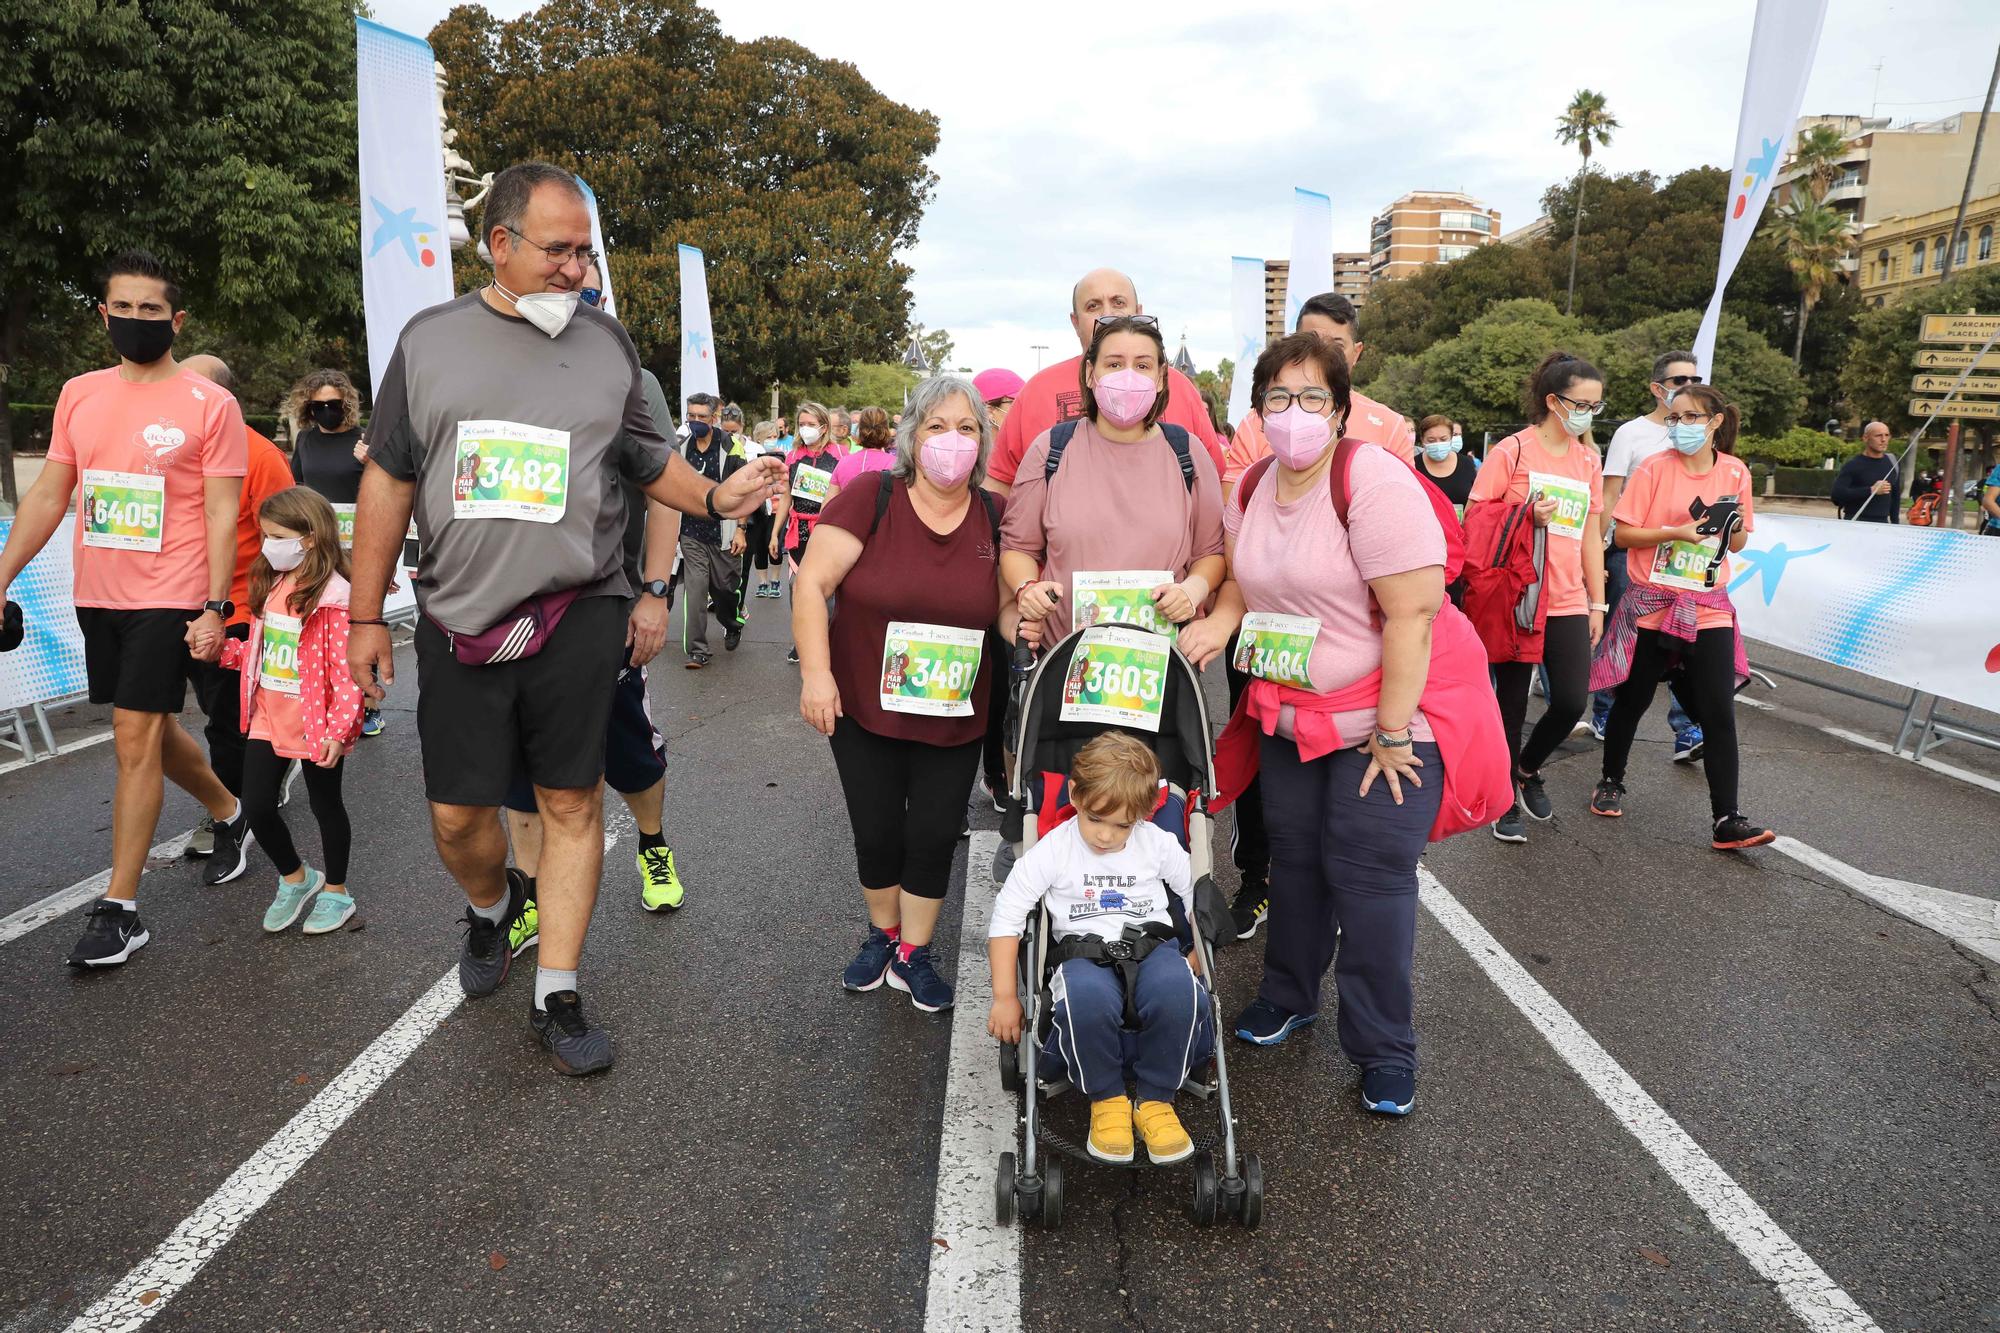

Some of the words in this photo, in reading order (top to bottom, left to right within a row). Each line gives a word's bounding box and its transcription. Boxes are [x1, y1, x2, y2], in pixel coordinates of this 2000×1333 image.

[480, 456, 562, 494] 3482
[458, 479, 474, 487] MAR
[458, 487, 472, 495] CHA
[95, 498, 160, 529] 6405
[262, 640, 299, 672] 40
[1250, 647, 1307, 683] 3484
[887, 674, 902, 683] MAR
[911, 657, 973, 690] 3481
[1086, 661, 1160, 701] 3603
[886, 681, 900, 689] CHA
[1068, 681, 1082, 690] MAR
[1067, 689, 1080, 698] CHA
[1083, 873, 1137, 888] LITTLE
